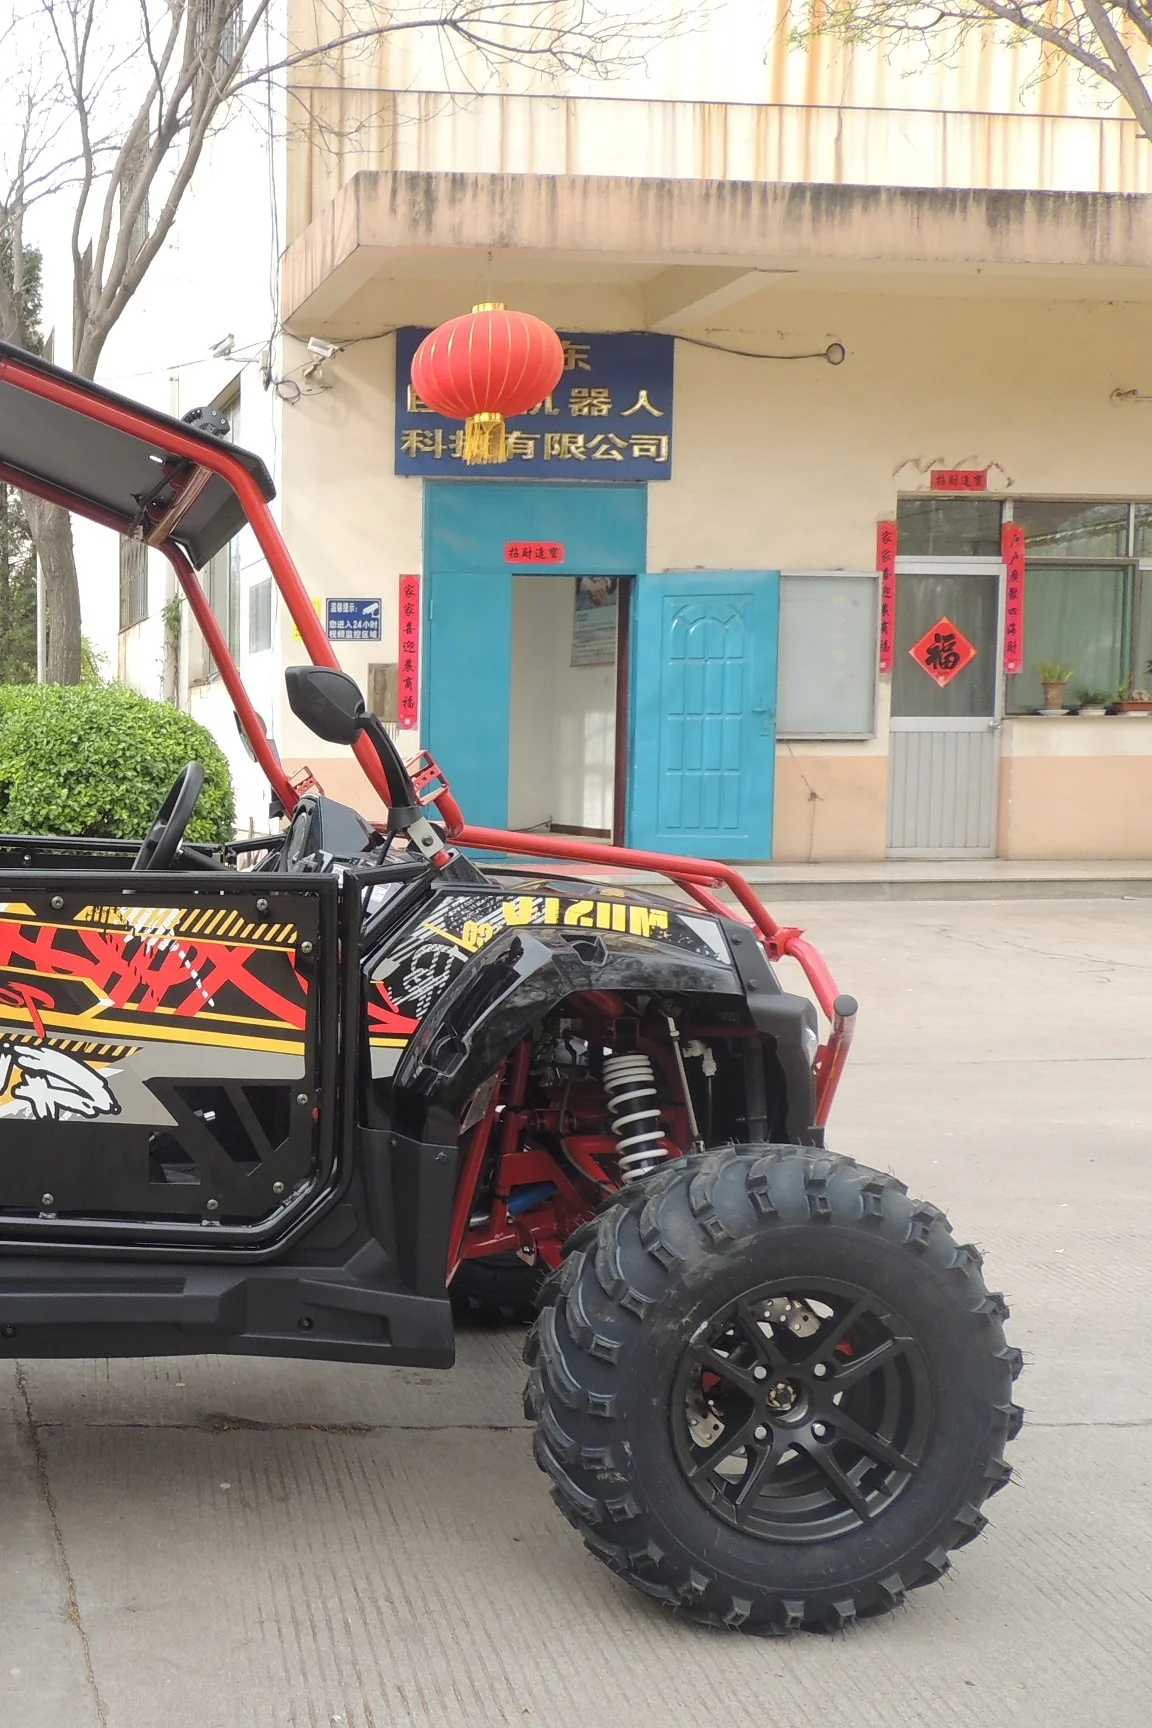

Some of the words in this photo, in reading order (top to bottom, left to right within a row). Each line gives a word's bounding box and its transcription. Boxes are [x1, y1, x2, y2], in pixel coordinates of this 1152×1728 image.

[329, 620, 378, 629] 您进入24小时
[329, 630, 378, 639] 视频监控区域
[925, 633, 961, 670] 福
